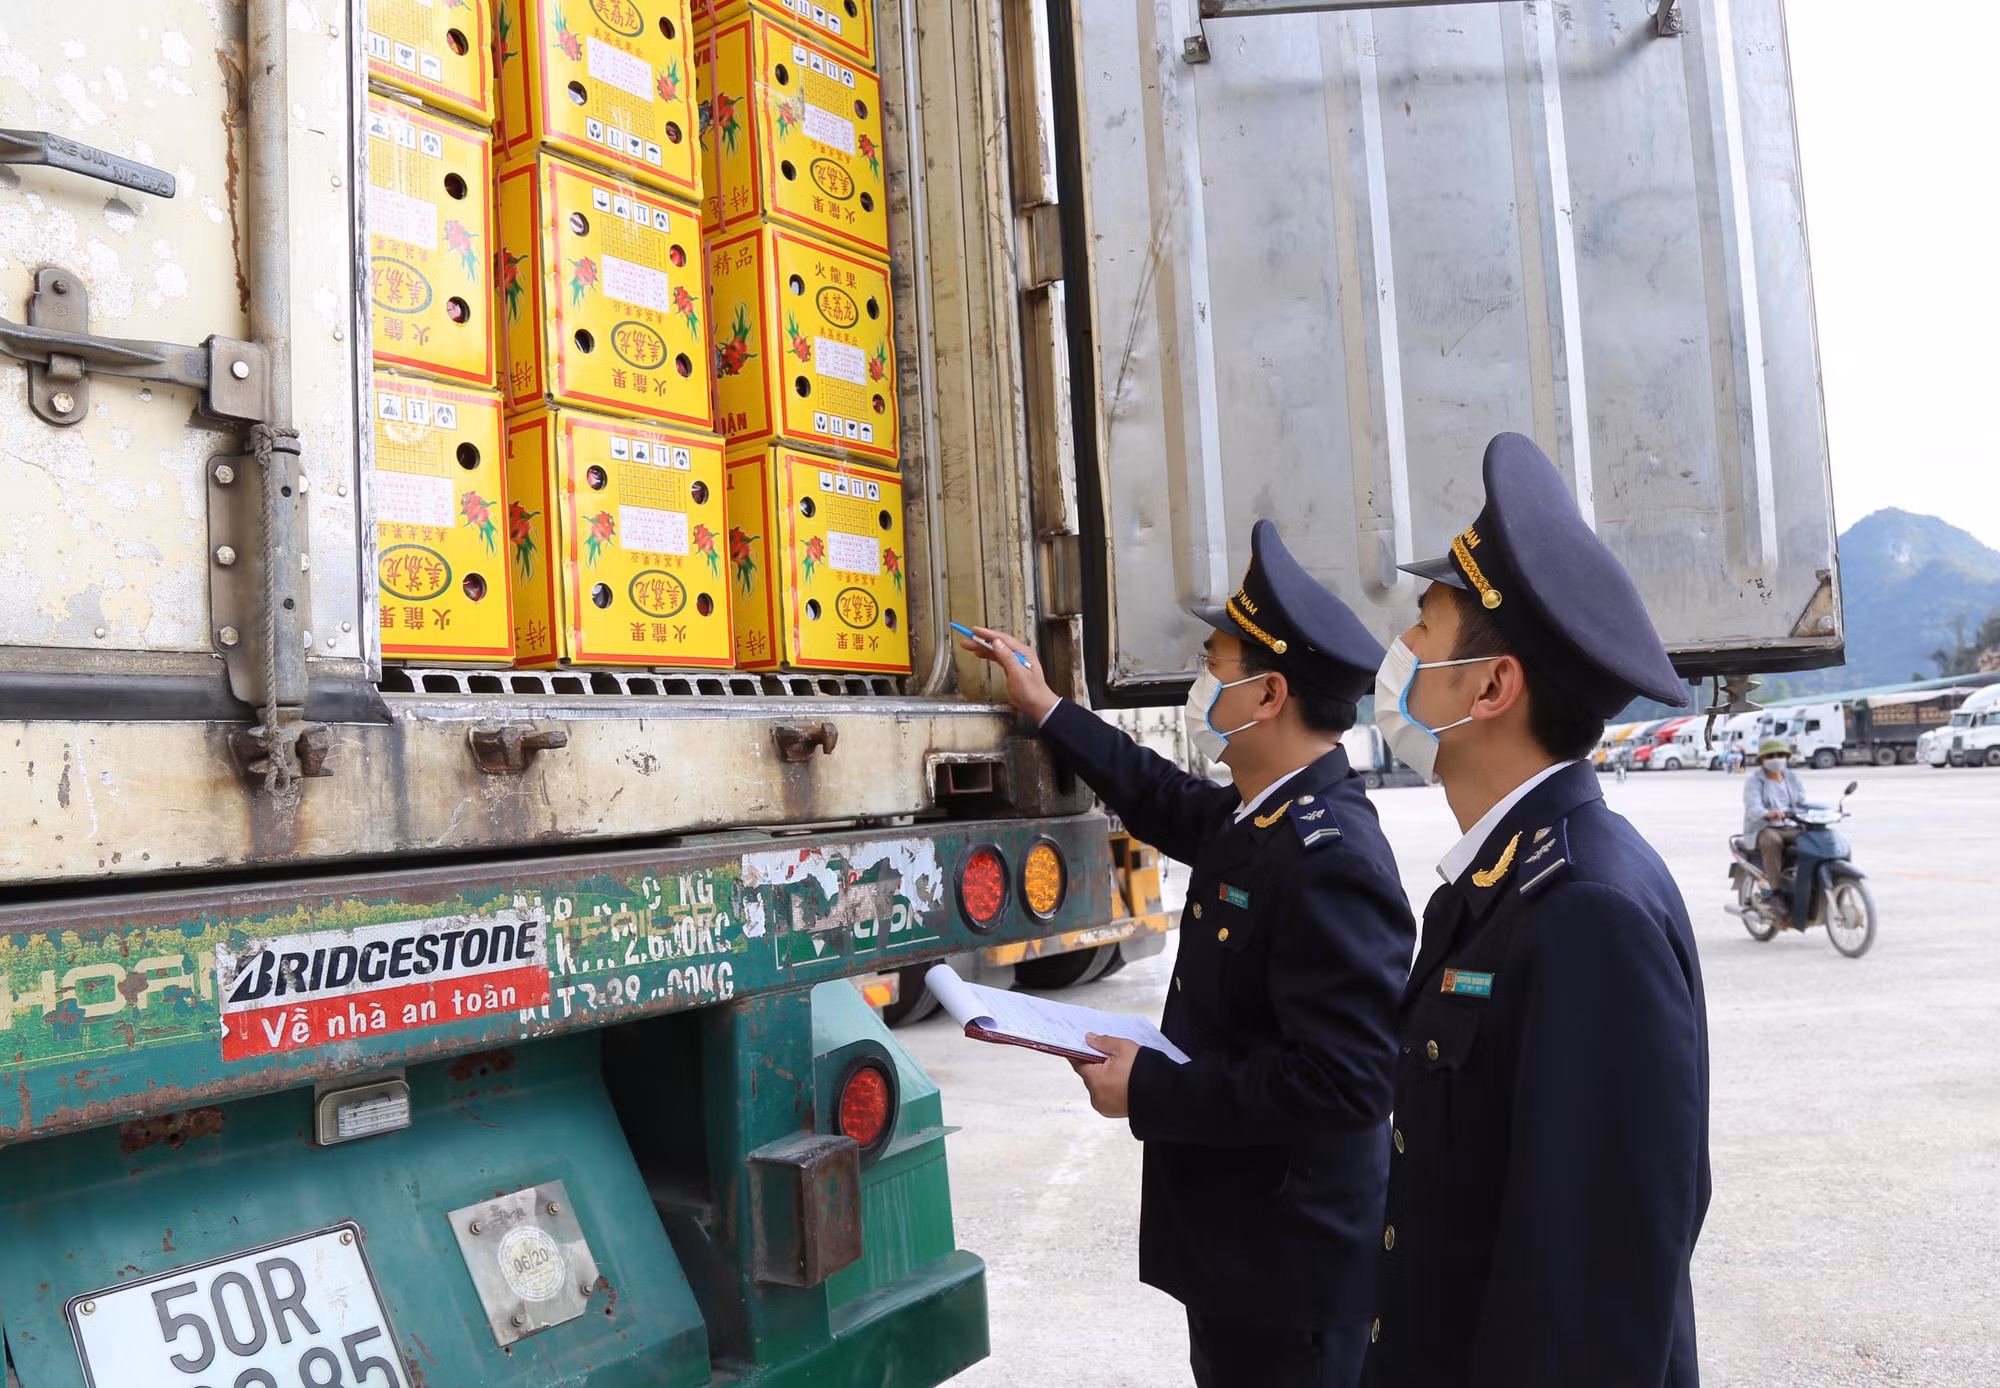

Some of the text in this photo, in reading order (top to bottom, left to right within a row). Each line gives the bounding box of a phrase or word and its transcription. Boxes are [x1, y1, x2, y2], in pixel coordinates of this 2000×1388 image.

[712, 245, 753, 277] 精品
[815, 261, 858, 290] 火龍果
[611, 367, 667, 397] 火龍果
[379, 606, 452, 631] 火龍果
[630, 621, 688, 644] 火龍果
[836, 631, 880, 652] 火龍果
[228, 920, 538, 1003] BRIDGESTONE
[261, 1006, 310, 1049] Về
[328, 1001, 387, 1038] nhà
[401, 998, 438, 1025] an
[451, 983, 517, 1016] toàn
[512, 1246, 550, 1275] 06/20
[150, 1256, 321, 1374] 50R
